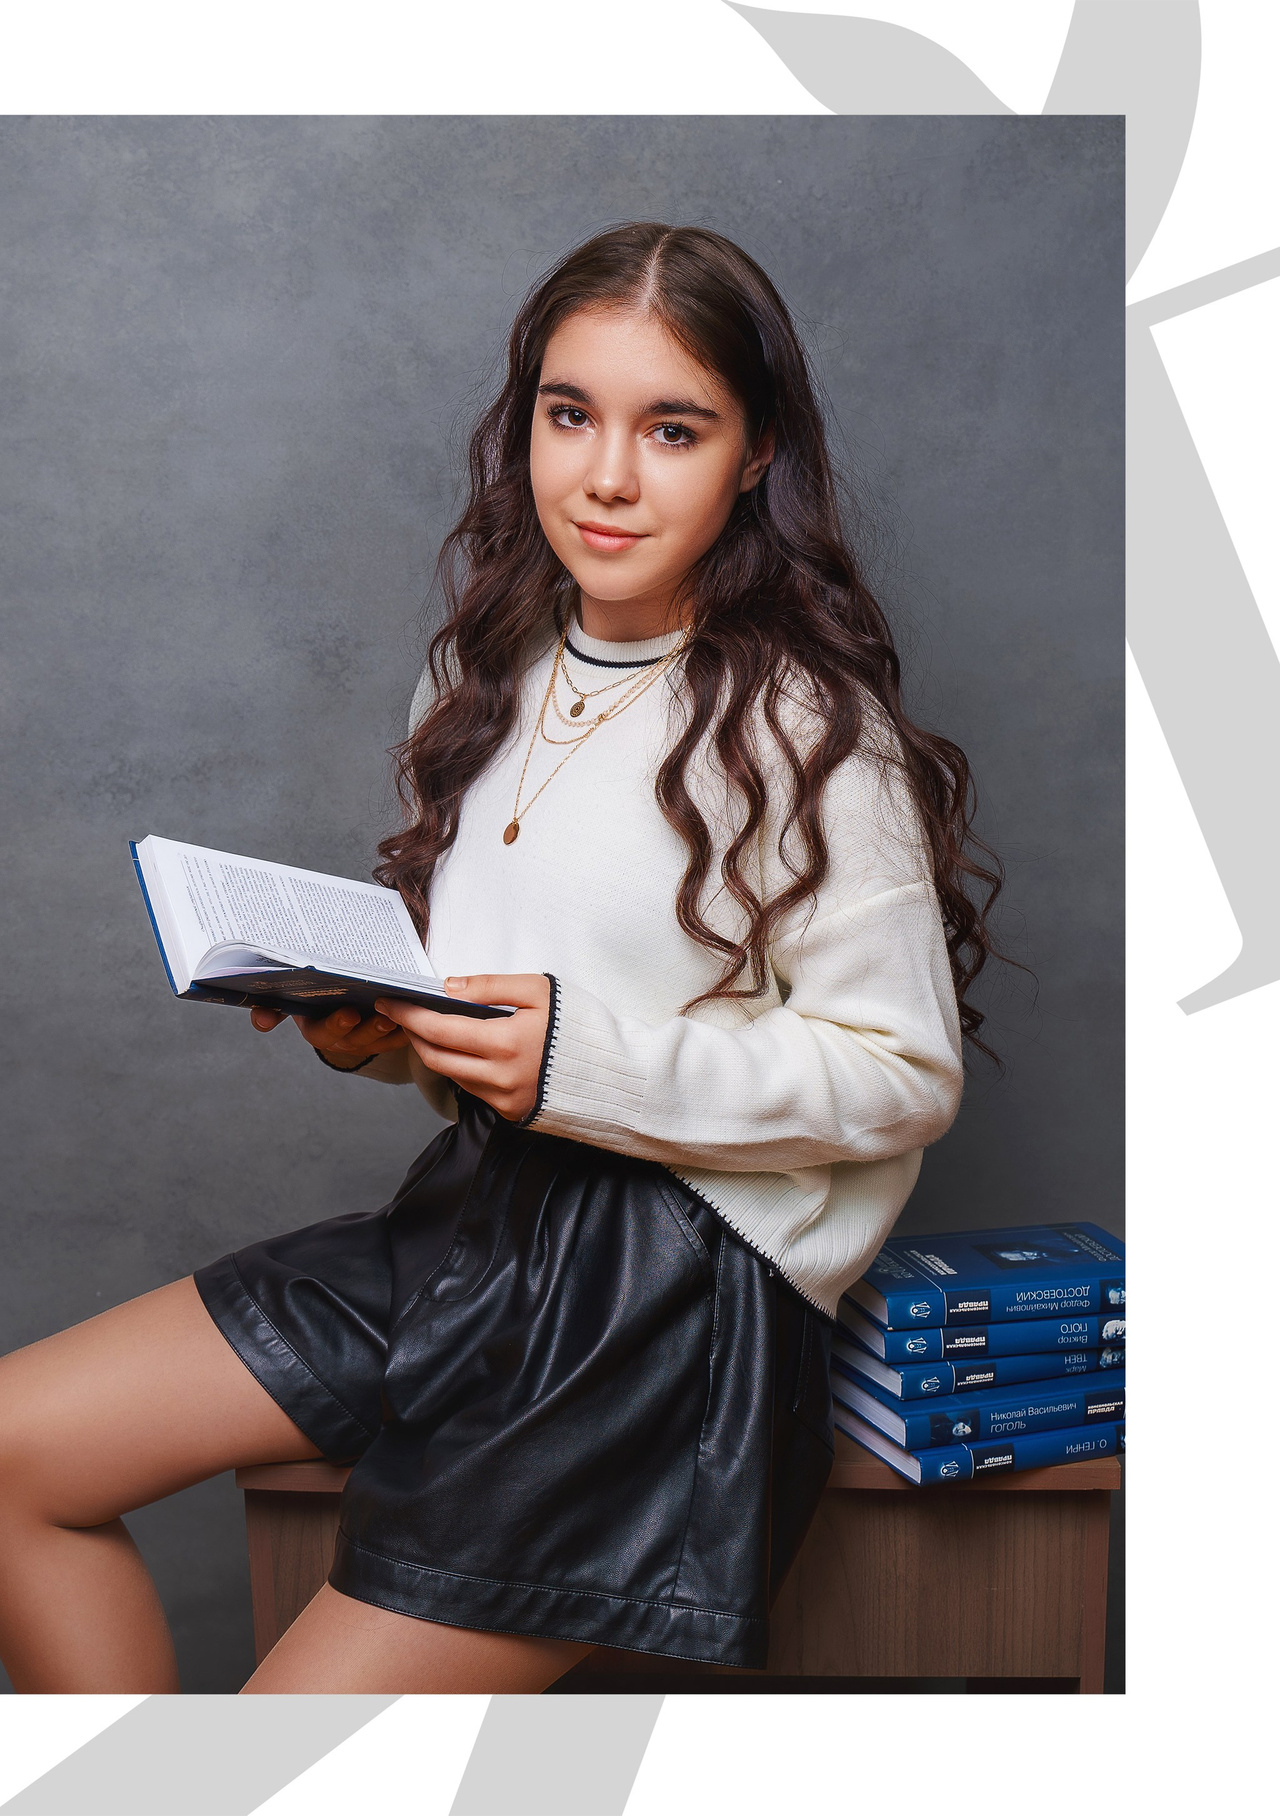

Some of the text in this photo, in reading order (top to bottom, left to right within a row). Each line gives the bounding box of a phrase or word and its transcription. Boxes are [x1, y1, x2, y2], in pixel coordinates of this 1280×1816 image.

[1015, 1285, 1090, 1302] ДОСТОЕВСКИЙ
[957, 1300, 988, 1308] ПРАВДА
[1006, 1299, 1090, 1313] Федор Михайлович
[1060, 1322, 1088, 1333] ГЮГО
[954, 1336, 986, 1344] ПРАВДА
[1057, 1335, 1088, 1344] Виктор
[1064, 1354, 1087, 1364] ТВЕН
[1065, 1364, 1087, 1374] Марк
[965, 1372, 994, 1381] ПРАВДА
[991, 1403, 1077, 1421] Николай Васильевич
[1087, 1406, 1115, 1415] ПРАВДА
[991, 1421, 1026, 1433] ГОГОЛЬ
[1065, 1439, 1107, 1453] О. ГЕНРИ
[984, 1454, 1012, 1464] ПРАВДА
